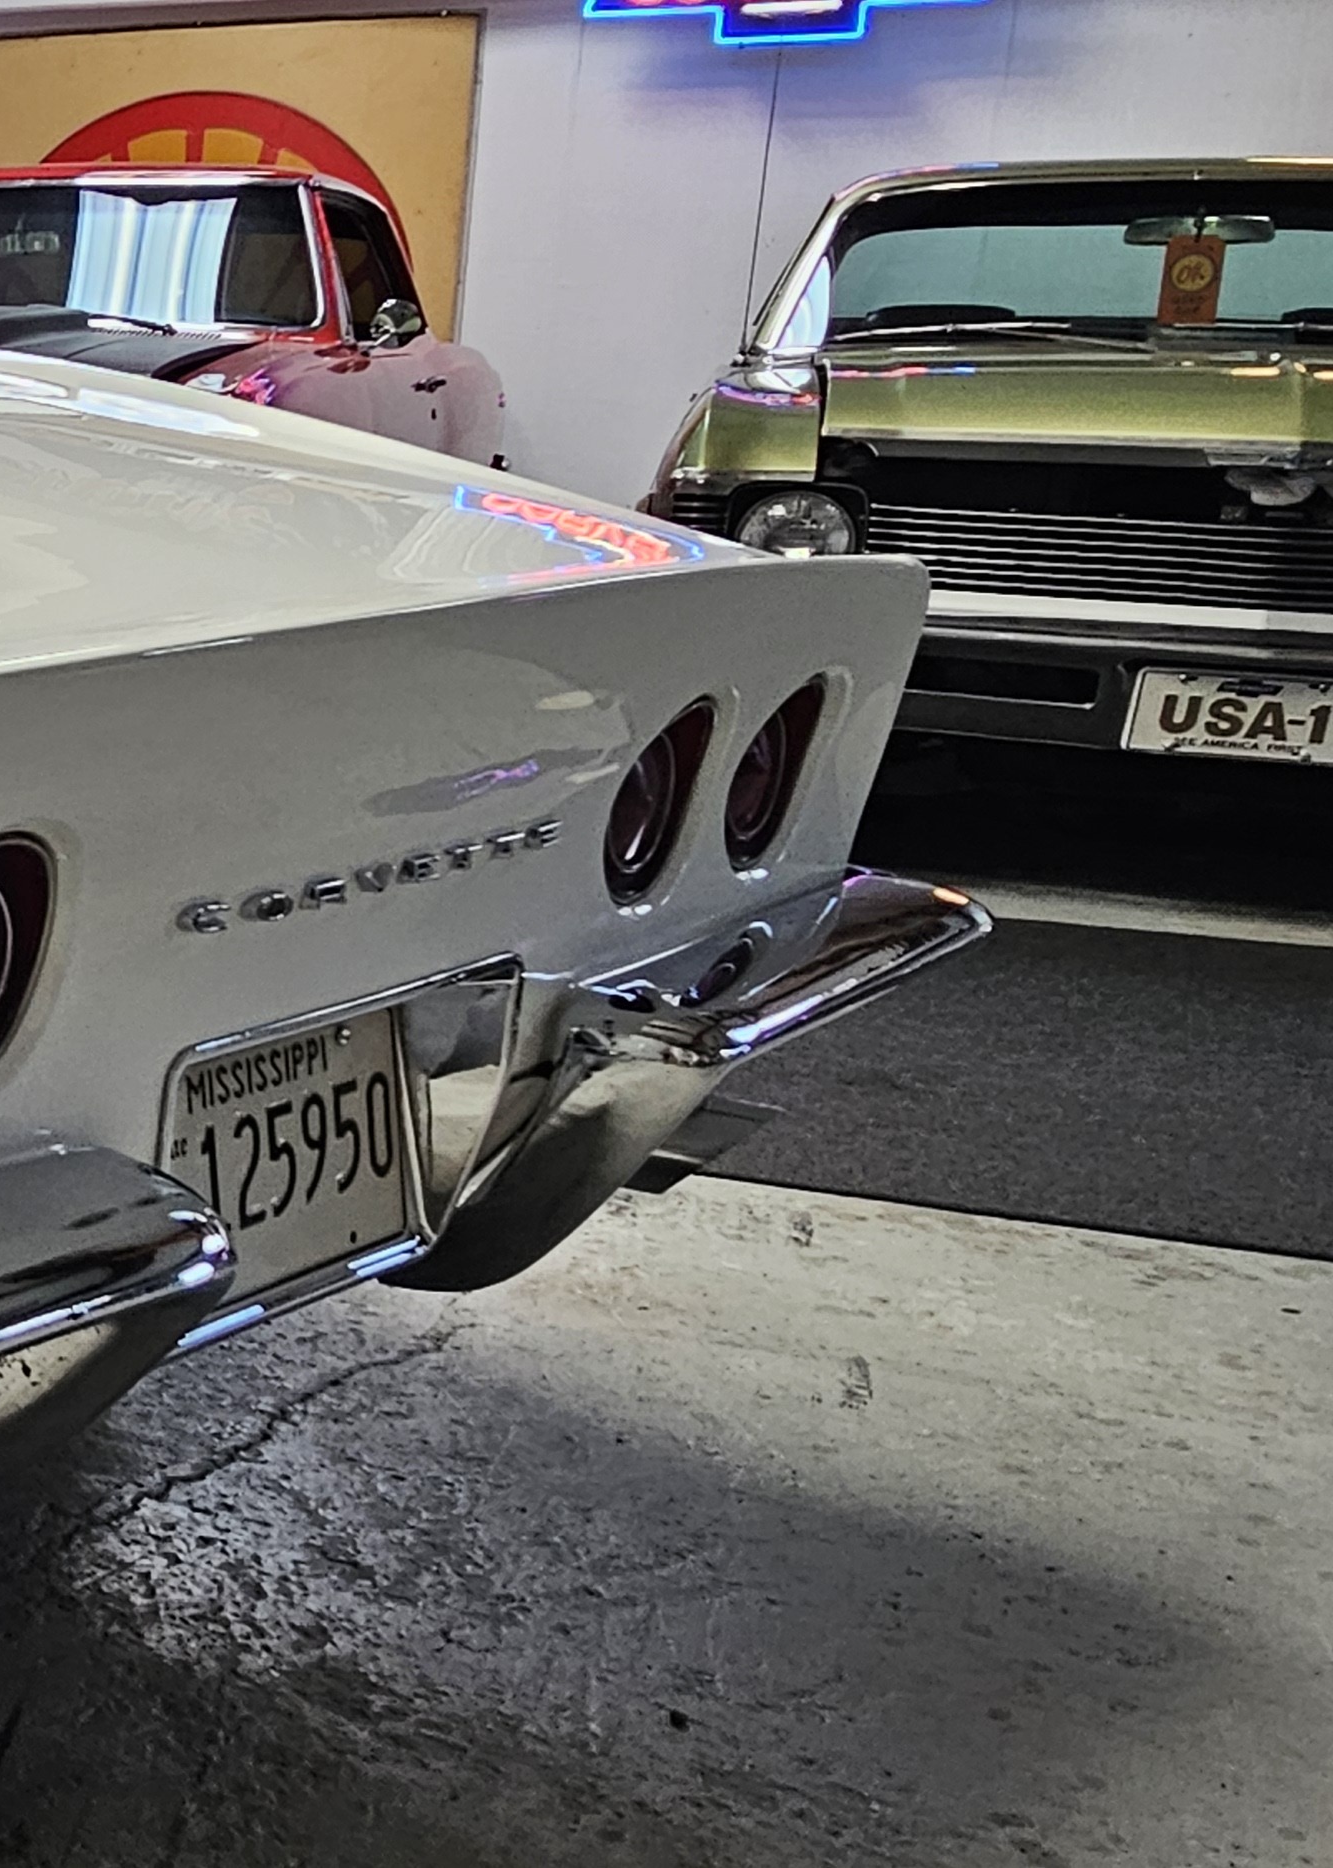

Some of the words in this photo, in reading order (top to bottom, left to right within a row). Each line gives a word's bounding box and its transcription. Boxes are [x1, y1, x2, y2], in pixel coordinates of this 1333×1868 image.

[1159, 694, 1331, 745] USA-1
[1200, 739, 1259, 751] AMERICA
[175, 818, 564, 934] CORVETTE
[185, 1034, 328, 1115] MISSISSIPPI
[200, 1071, 393, 1232] 125950
